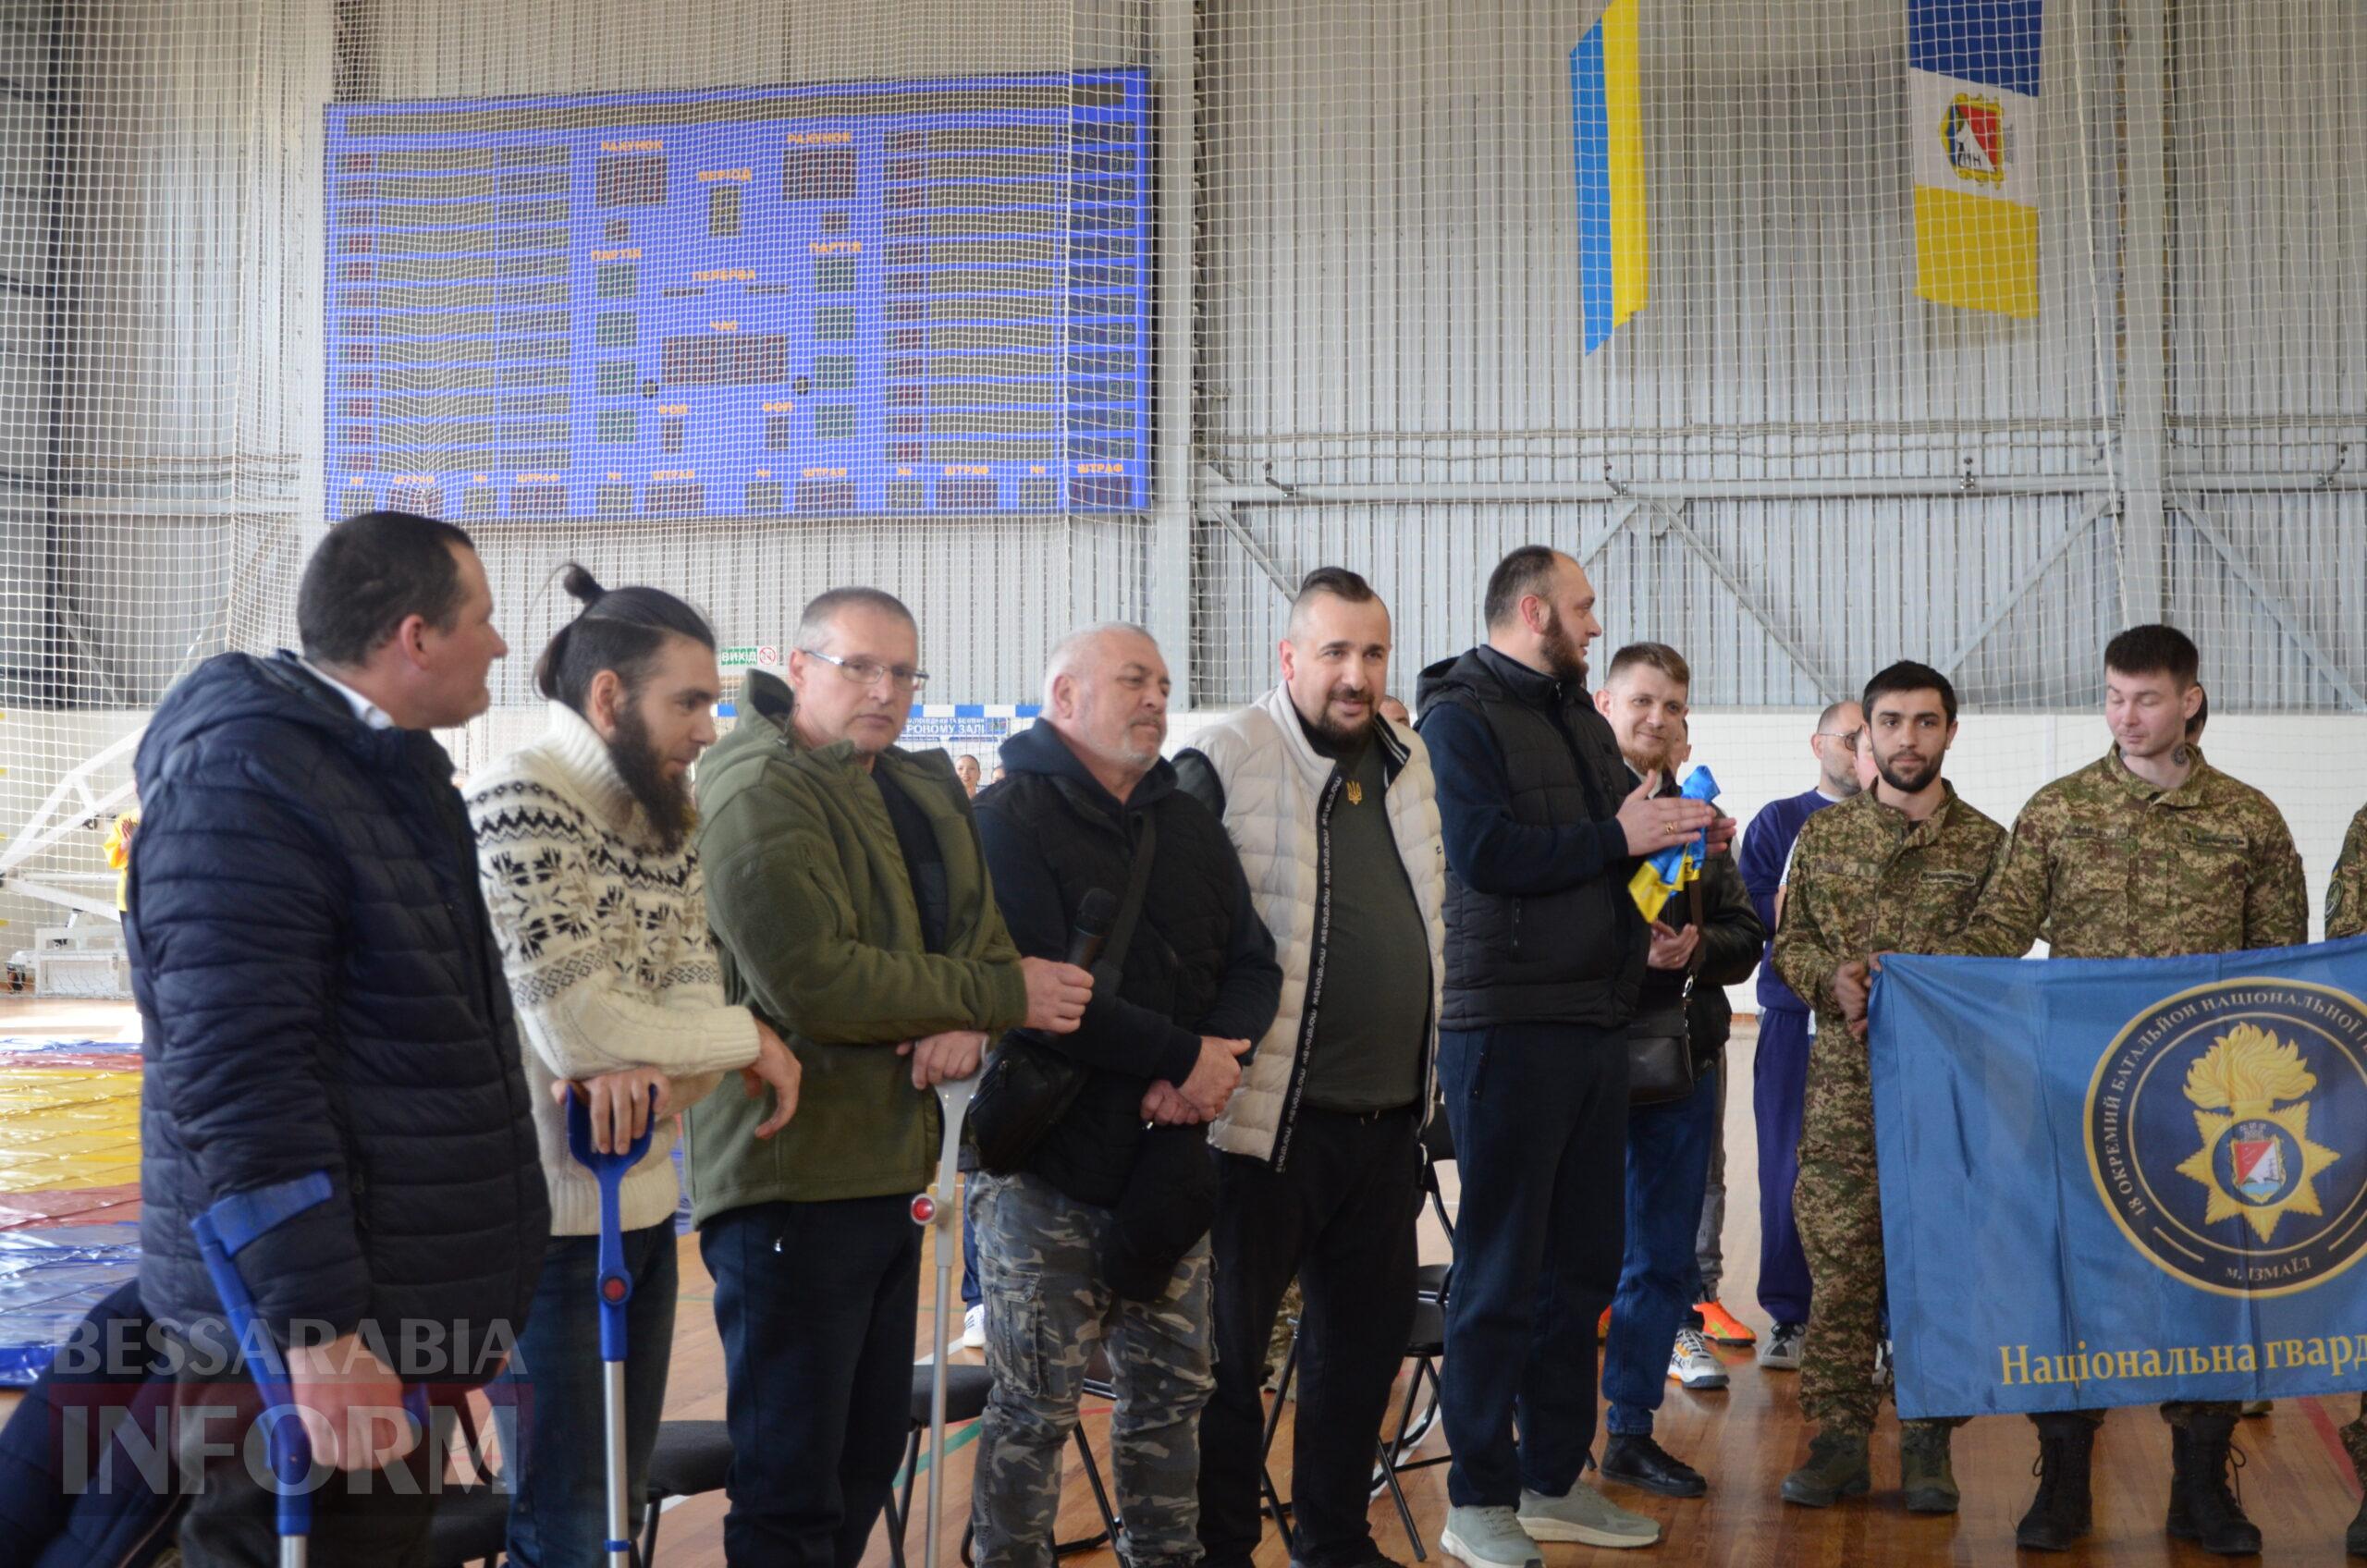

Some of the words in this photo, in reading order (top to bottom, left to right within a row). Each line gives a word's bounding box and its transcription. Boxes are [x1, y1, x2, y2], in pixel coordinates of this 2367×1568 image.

[1077, 463, 1123, 474] ШТРАФ
[2201, 992, 2362, 1034] НАЦІОНАЛЬНОЇ
[2111, 1004, 2198, 1091] БАТАЛЬЙОН
[2103, 1096, 2133, 1194] ОКРЕМИЙ
[2128, 1197, 2147, 1216] 18
[2249, 1257, 2311, 1280] ІЗМАЇЛ
[1998, 1341, 2258, 1388] Національна
